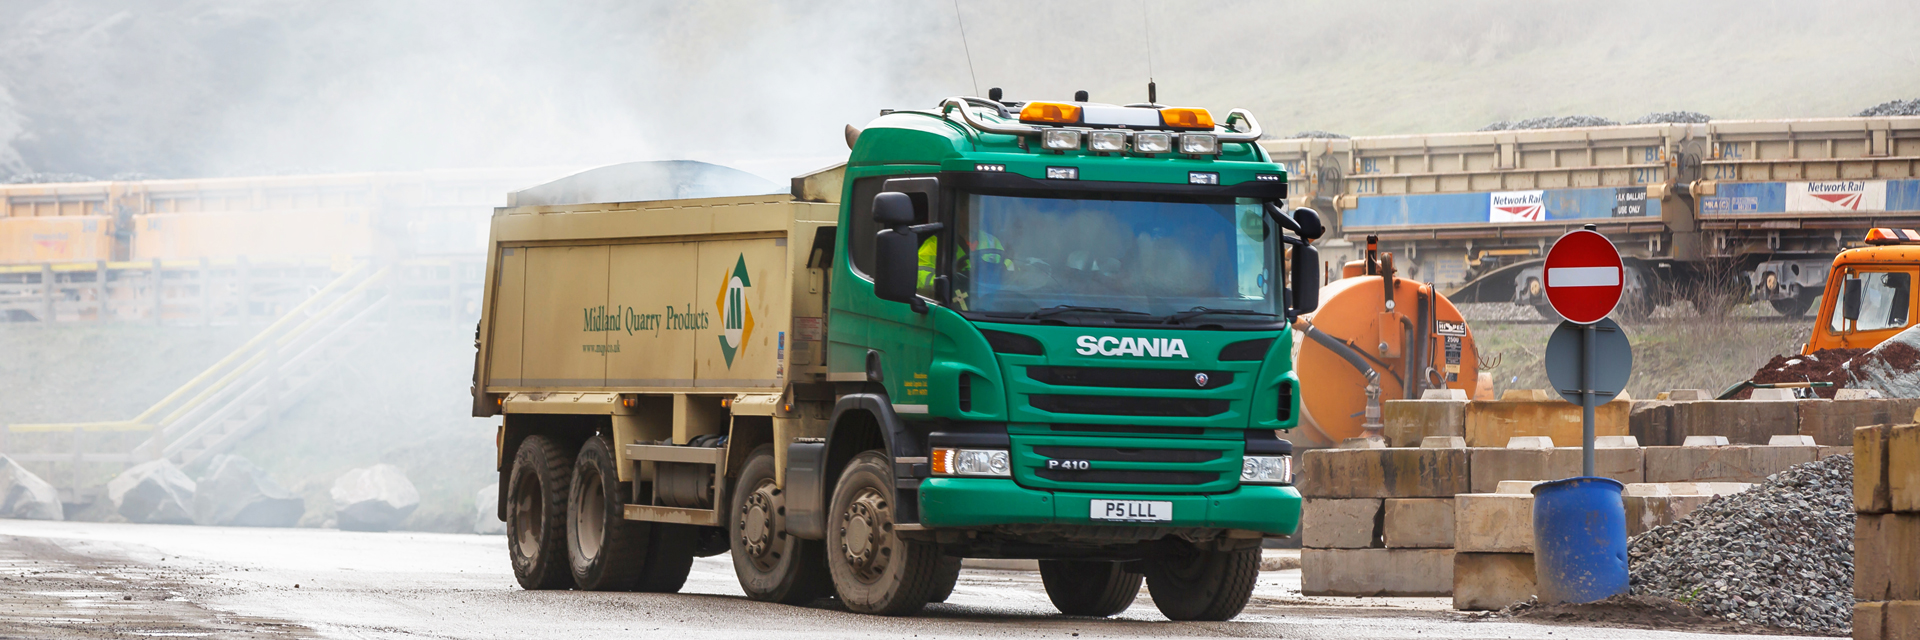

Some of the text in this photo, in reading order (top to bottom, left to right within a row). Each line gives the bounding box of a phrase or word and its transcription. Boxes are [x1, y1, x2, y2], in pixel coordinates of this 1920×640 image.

[1723, 142, 1742, 158] AL
[1364, 158, 1380, 173] BL
[1714, 165, 1736, 180] 213
[1637, 168, 1657, 183] 211
[1808, 181, 1865, 192] Network Rail
[1493, 194, 1527, 206] Network
[1626, 192, 1647, 201] BALLAST
[1628, 206, 1641, 214] ONLY
[583, 303, 709, 338] Midland Quarry Products
[1076, 335, 1189, 358] SCANIA
[1048, 460, 1089, 470] P 410
[1106, 502, 1156, 517] P5 LLL
